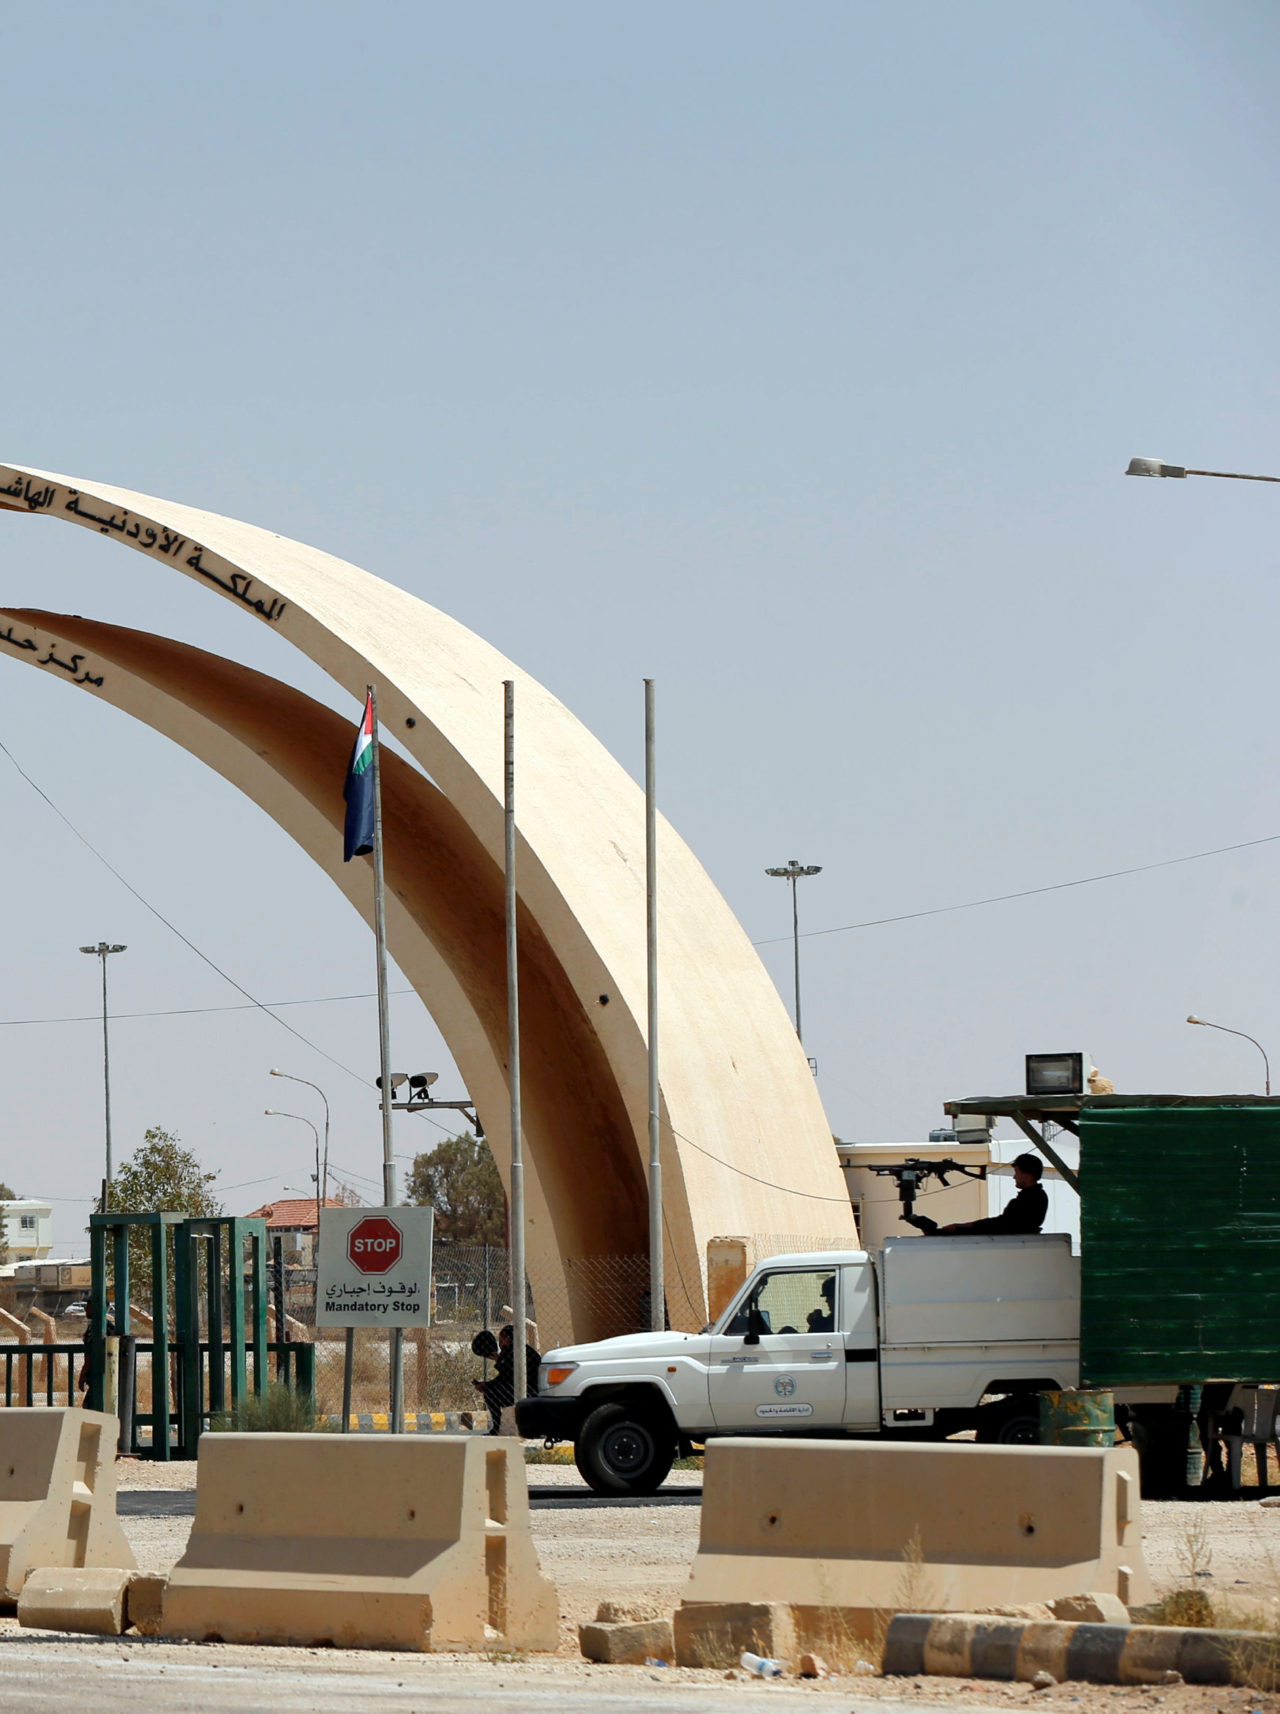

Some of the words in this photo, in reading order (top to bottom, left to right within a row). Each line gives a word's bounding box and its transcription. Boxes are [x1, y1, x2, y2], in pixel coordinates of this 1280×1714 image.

[186, 546, 287, 621] المملكة
[37, 643, 104, 688] مركز
[354, 1239, 396, 1252] STOP
[325, 1301, 389, 1314] Mandatory
[392, 1301, 420, 1314] Stop
